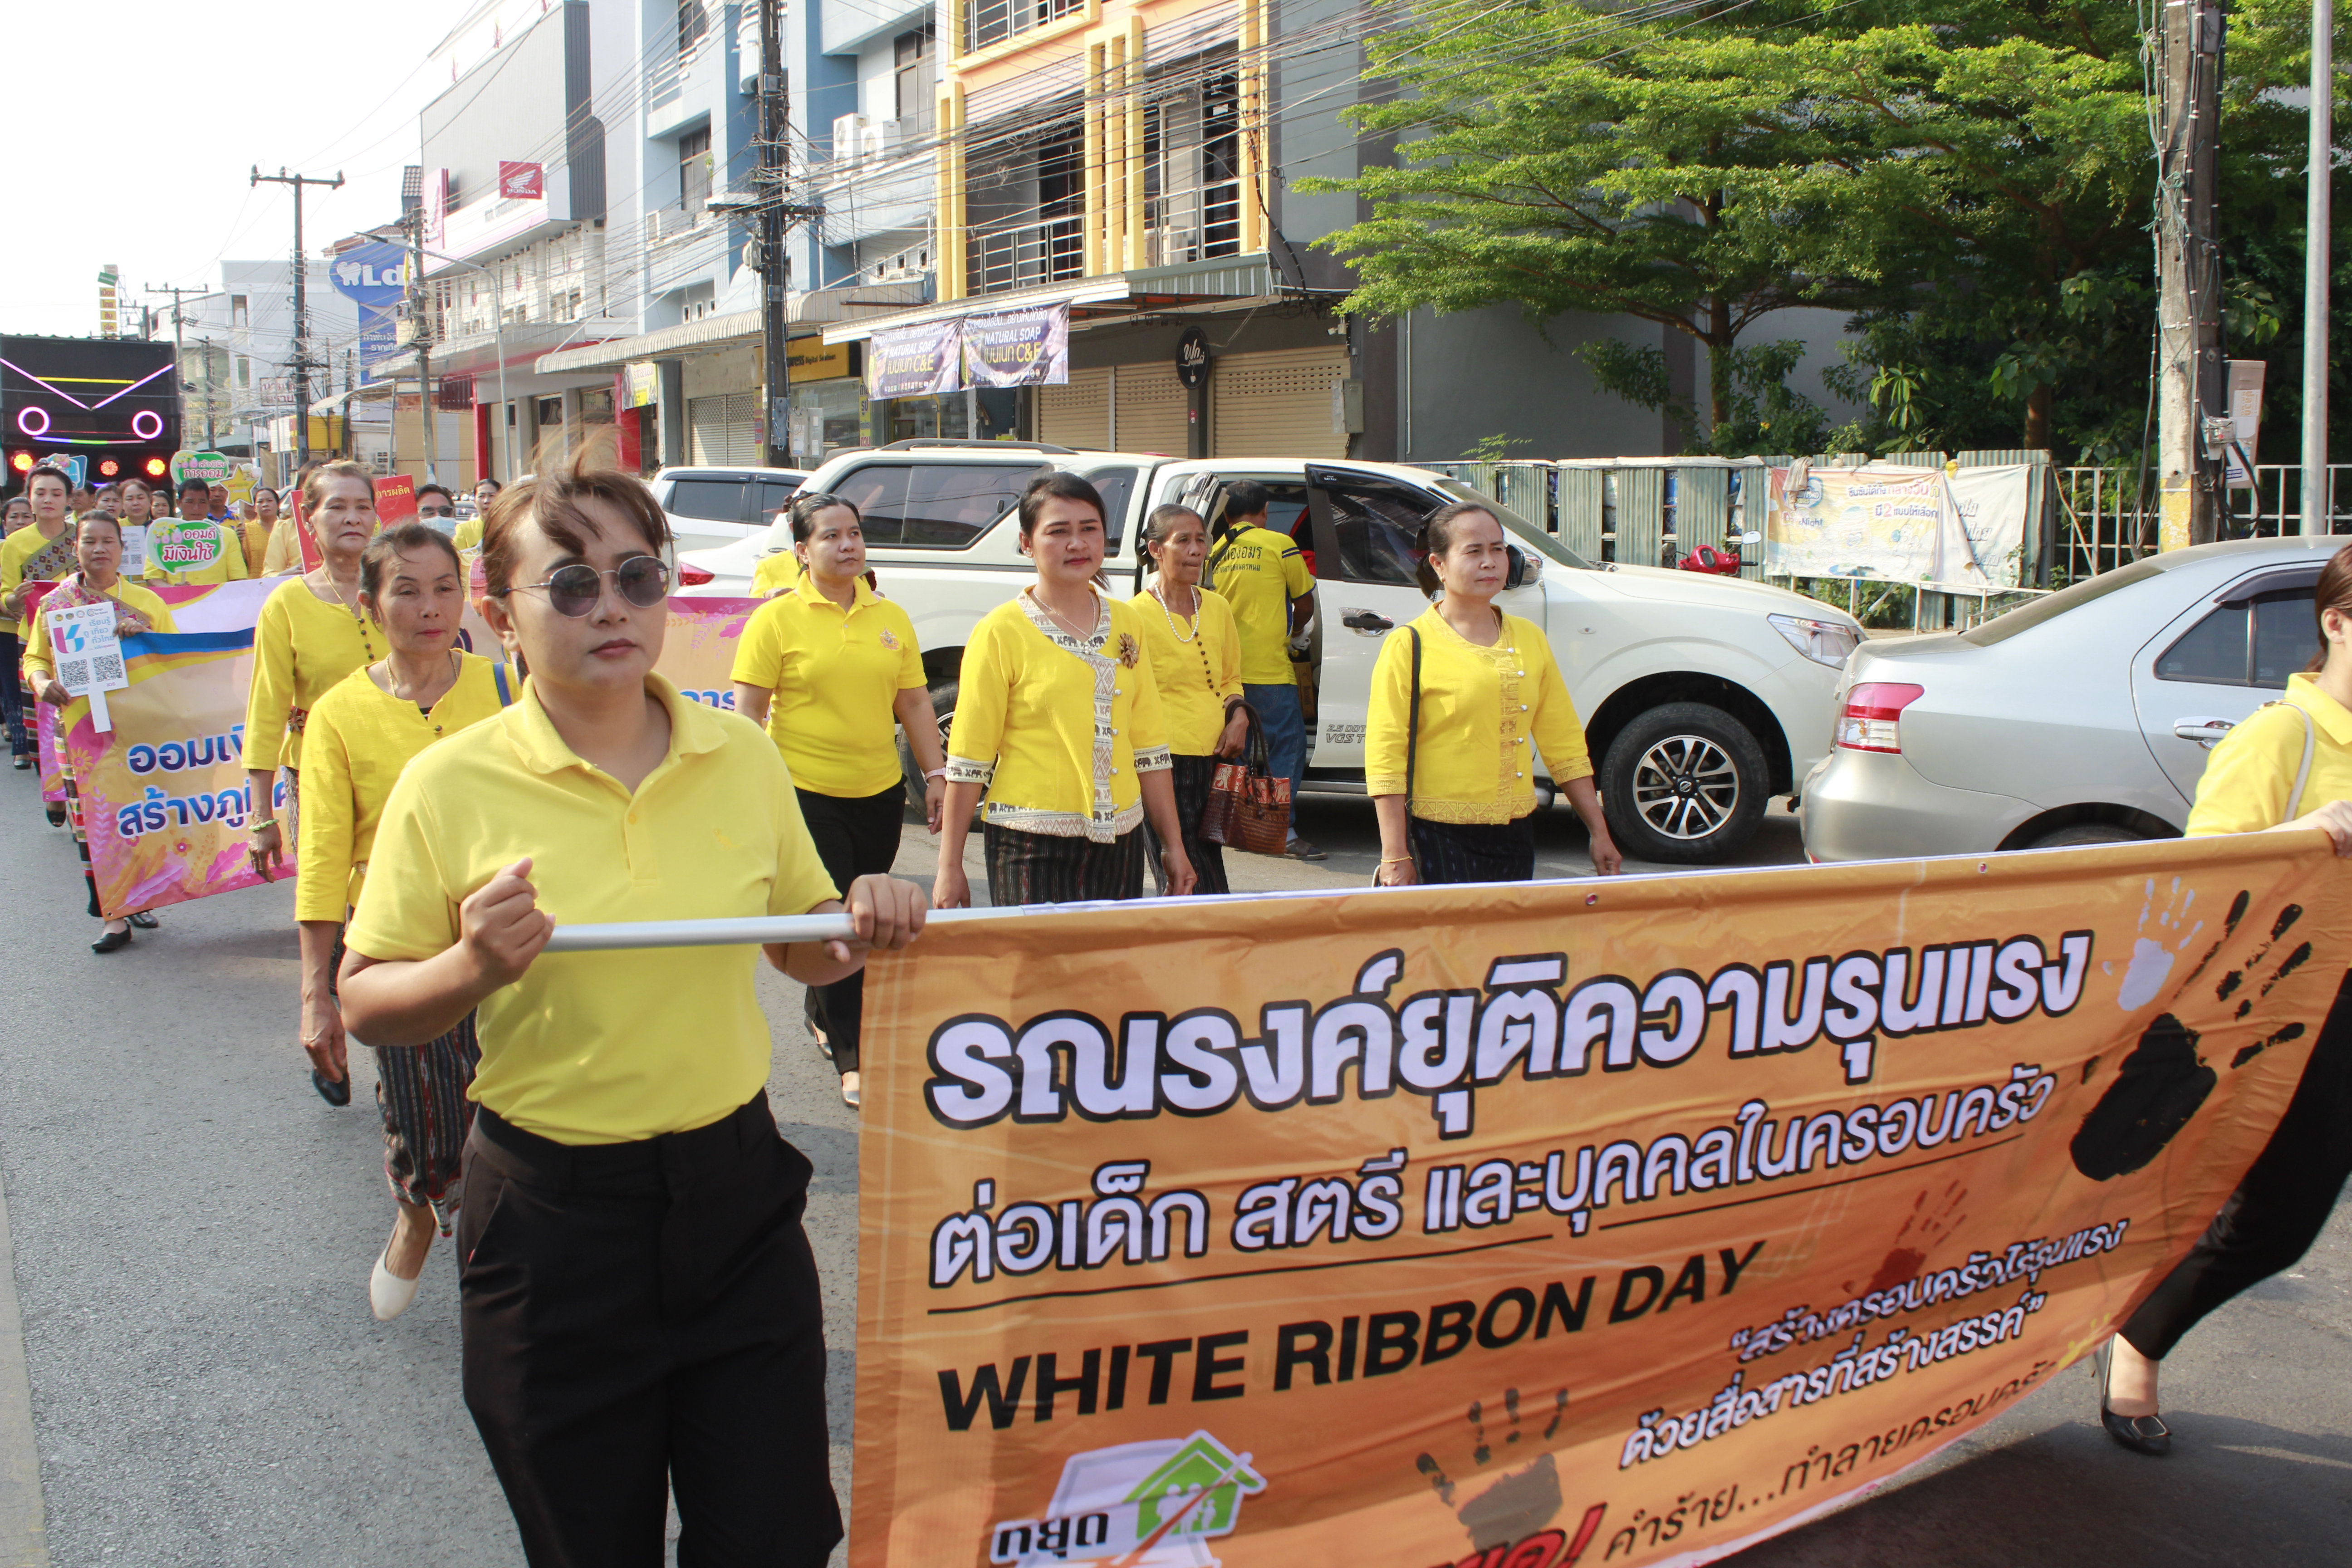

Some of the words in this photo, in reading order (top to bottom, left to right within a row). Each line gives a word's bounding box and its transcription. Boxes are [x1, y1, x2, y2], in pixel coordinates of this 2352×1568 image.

[985, 329, 1018, 345] NATURAL
[1019, 326, 1041, 341] SOAP
[889, 343, 916, 358] NATURAL
[918, 340, 936, 354] SOAP
[913, 353, 935, 373] C&E
[184, 469, 224, 478] การออม
[1884, 503, 1892, 517] 2
[184, 528, 216, 539] ออมดี
[163, 541, 215, 561] มีเงินใช้
[89, 616, 112, 627] เรียนรู้
[91, 625, 108, 635] เที่ยว
[1327, 724, 1344, 732] 2.5
[1326, 733, 1355, 744] VGS
[1357, 734, 1366, 744] T
[925, 929, 2094, 1139] รณรงค์ยุติความรุนแรง
[928, 1158, 1210, 1289] ต่อเด็ก
[1231, 1147, 1409, 1253] สตรี
[1423, 1063, 2058, 1238] และบุคคลในครอบครัว
[937, 1329, 1249, 1431] WHITE
[1274, 1276, 1596, 1392] RIBBON
[1608, 1240, 1766, 1325] DAY
[1603, 1359, 2058, 1562] คำร้าย...ทำลายครอบครั
